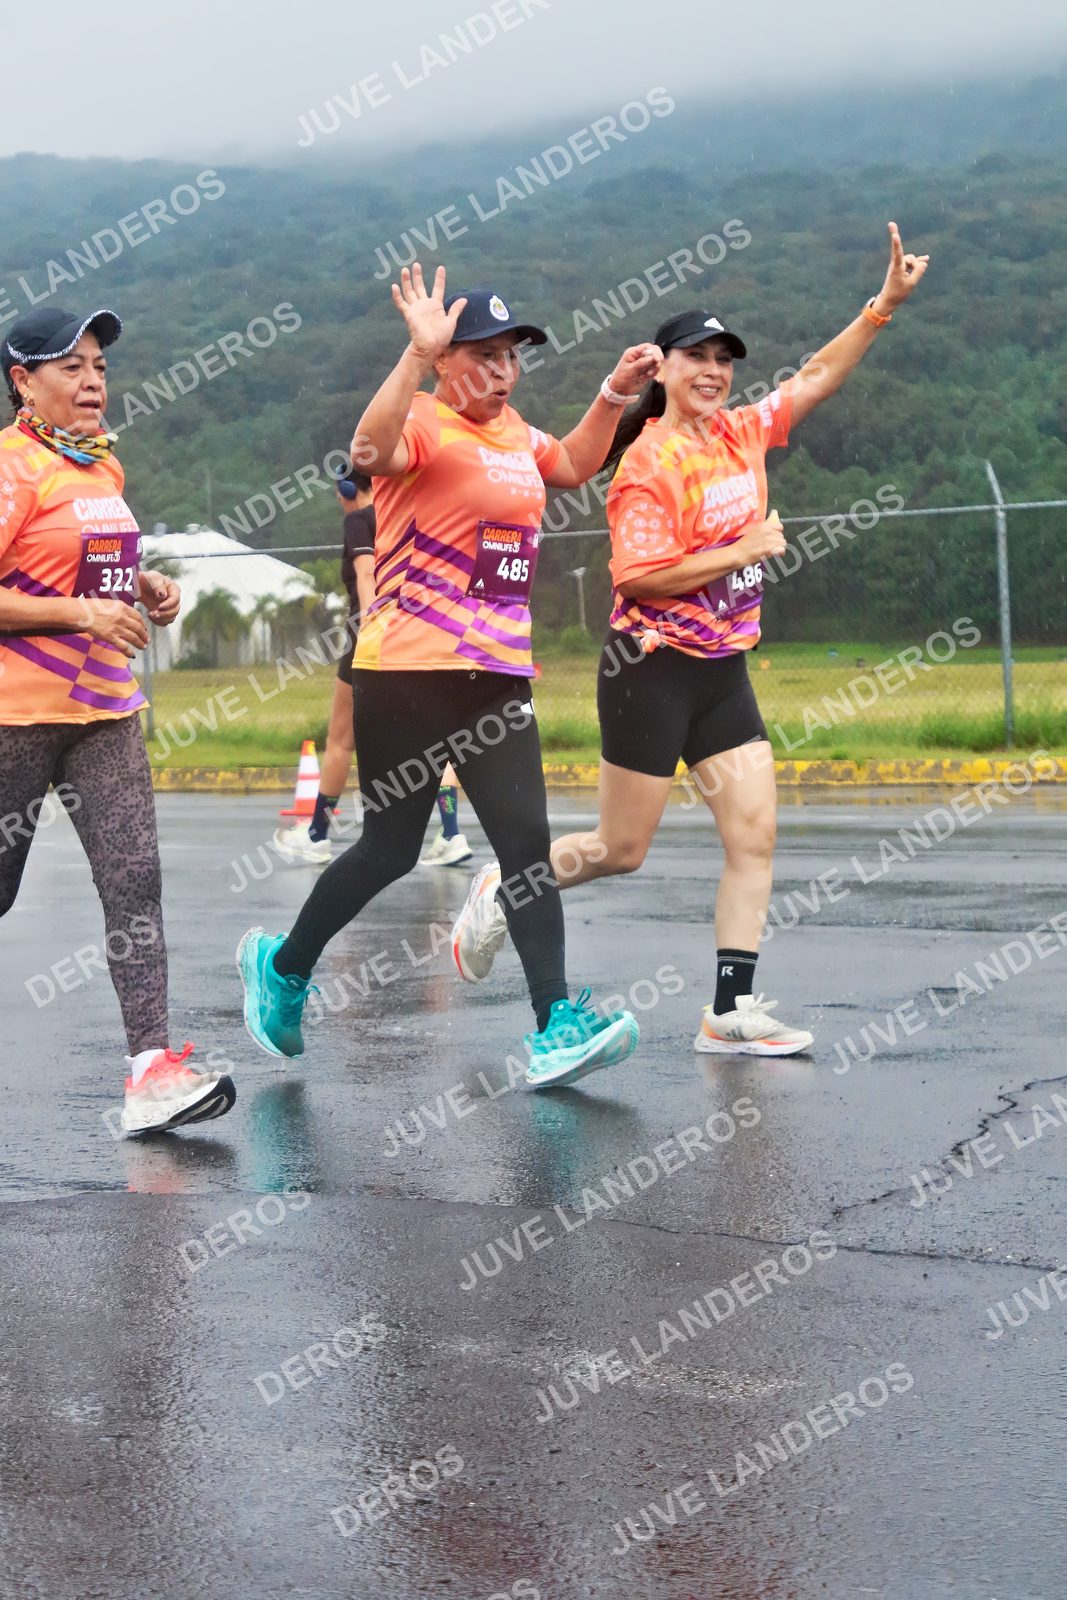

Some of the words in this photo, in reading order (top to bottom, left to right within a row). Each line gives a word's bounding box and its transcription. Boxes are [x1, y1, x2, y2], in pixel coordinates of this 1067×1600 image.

[87, 539, 121, 553] CARRERA
[483, 527, 522, 543] CARRERA
[99, 567, 133, 592] 322
[496, 557, 530, 582] 485
[732, 562, 763, 591] 486
